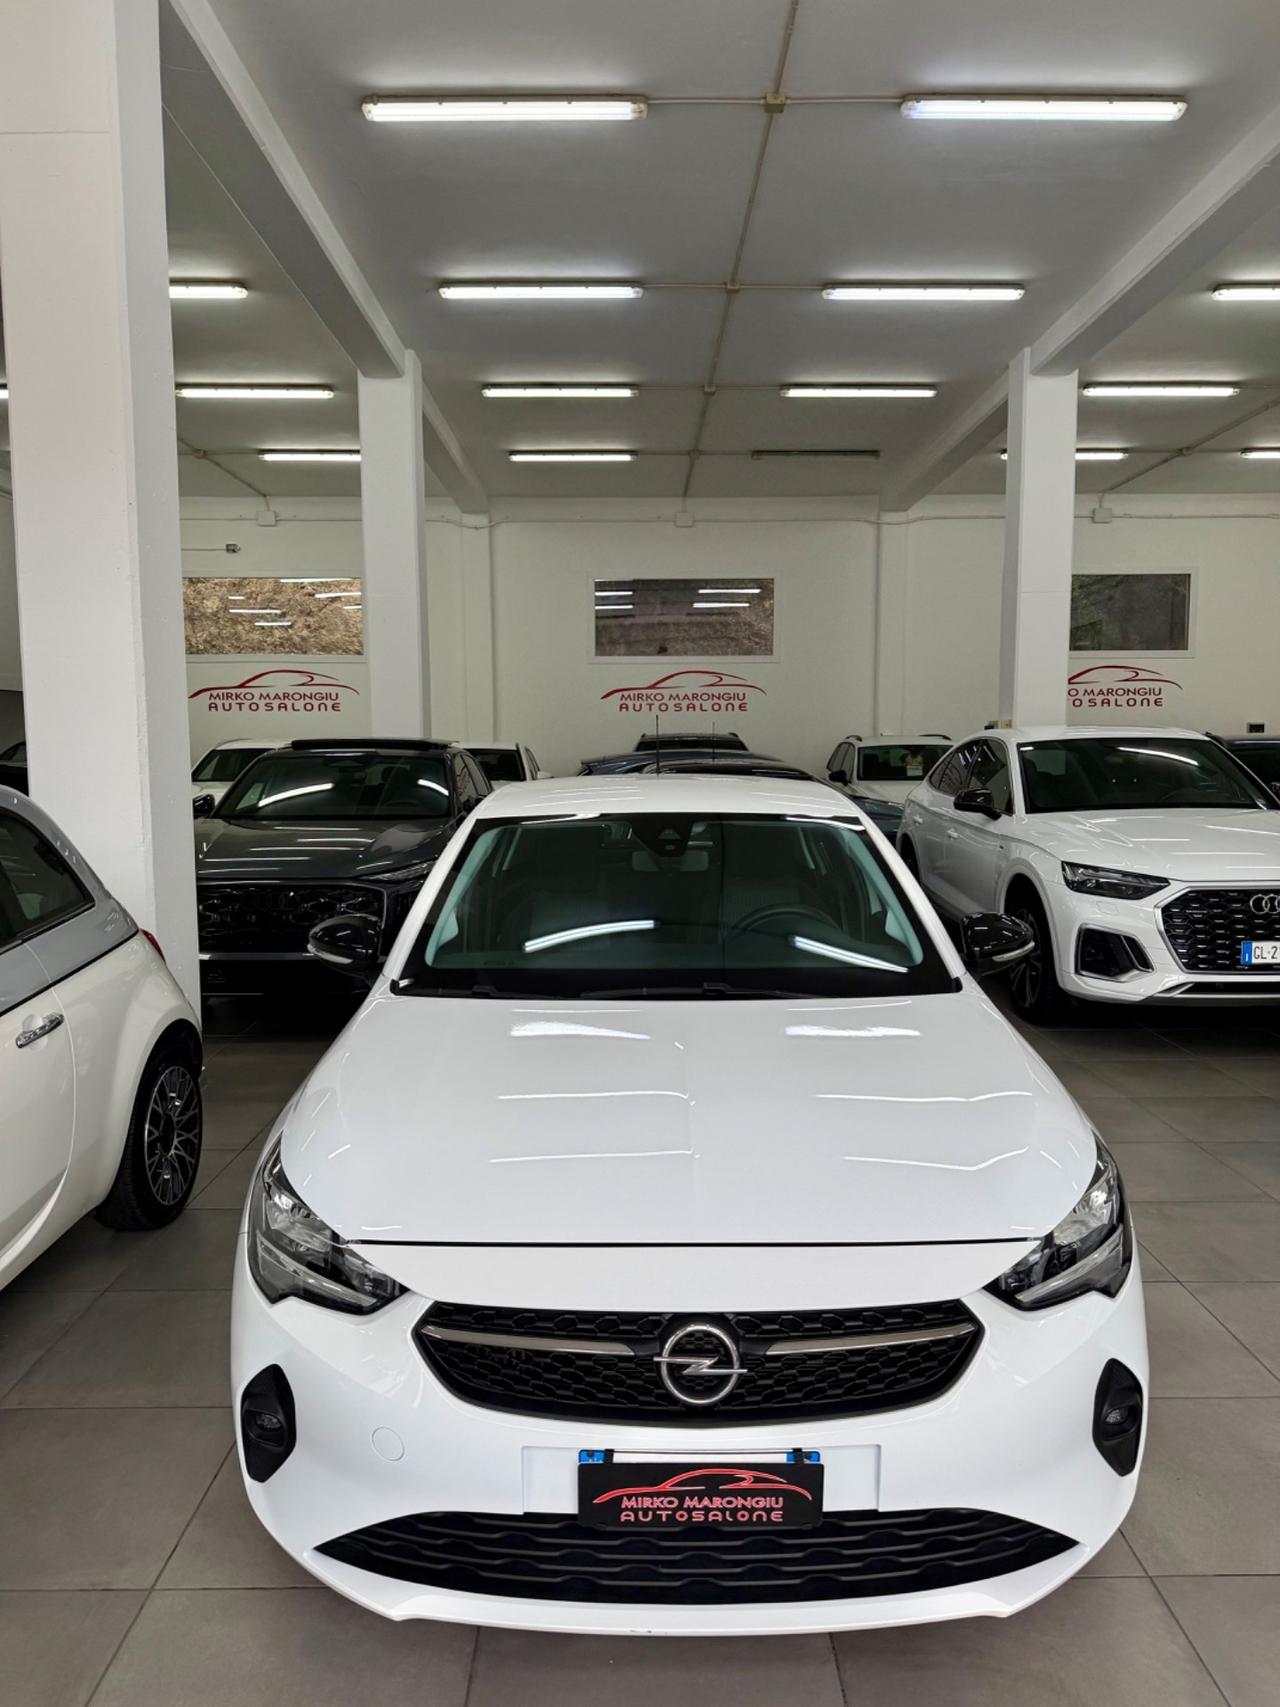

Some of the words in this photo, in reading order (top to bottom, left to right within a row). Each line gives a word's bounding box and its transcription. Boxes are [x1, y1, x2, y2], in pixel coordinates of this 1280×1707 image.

[208, 691, 255, 701] MIRKO
[258, 691, 339, 701] MARONGIU
[620, 692, 664, 701] MIRKO
[668, 692, 746, 701] MARONGIU
[1082, 687, 1162, 697] MARONGIU
[208, 702, 341, 712] AUTOSALONE
[619, 702, 748, 713] AUTOSALONE
[1072, 697, 1163, 708] OSALONE
[620, 1496, 679, 1509] MIRKO
[683, 1496, 784, 1509] MARONGIU
[620, 1510, 784, 1523] AUTOSALONE
